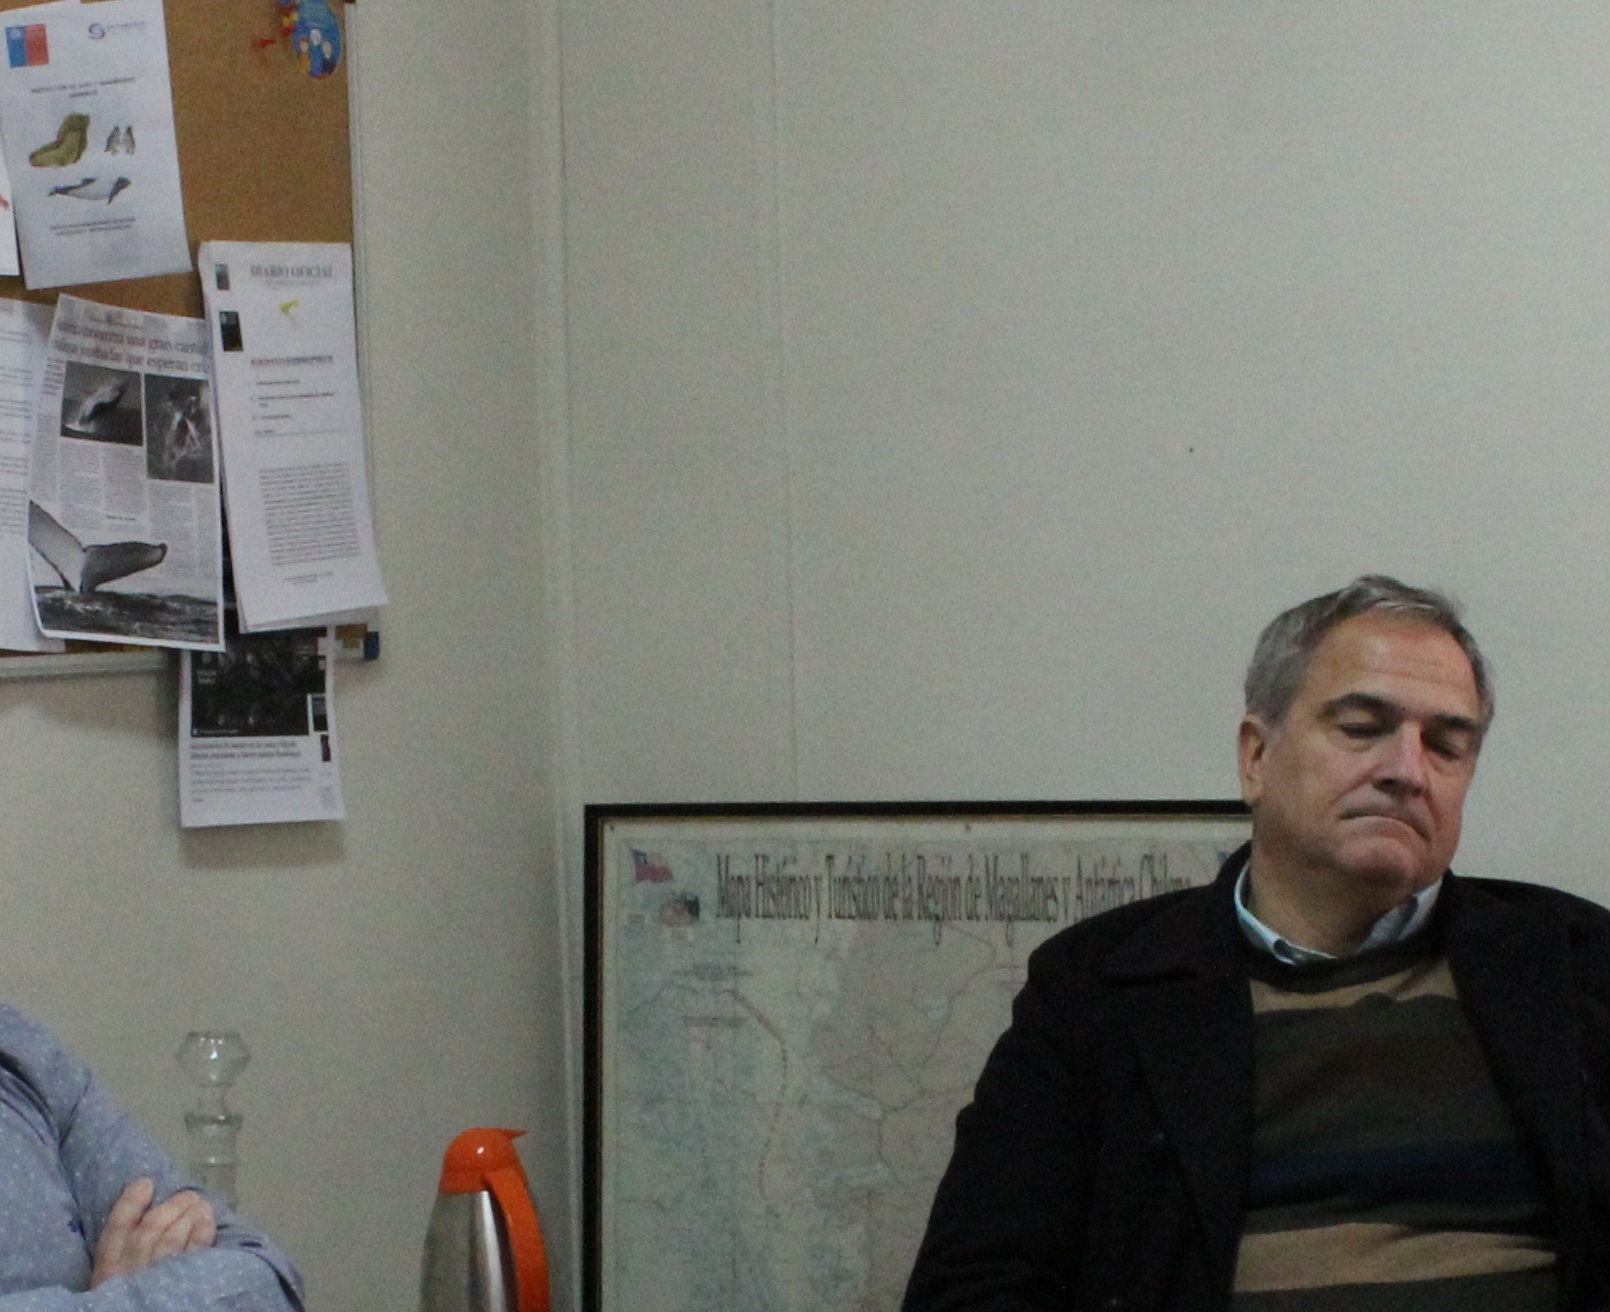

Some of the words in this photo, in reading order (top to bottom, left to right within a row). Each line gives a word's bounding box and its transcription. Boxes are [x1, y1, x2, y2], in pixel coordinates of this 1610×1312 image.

[251, 265, 289, 278] DIARIO
[716, 854, 751, 943] Mapa
[813, 875, 823, 944] y
[884, 852, 898, 921] de
[902, 853, 913, 921] la
[917, 854, 962, 945] Región
[965, 854, 981, 922] de
[984, 853, 1058, 947] Magallanes
